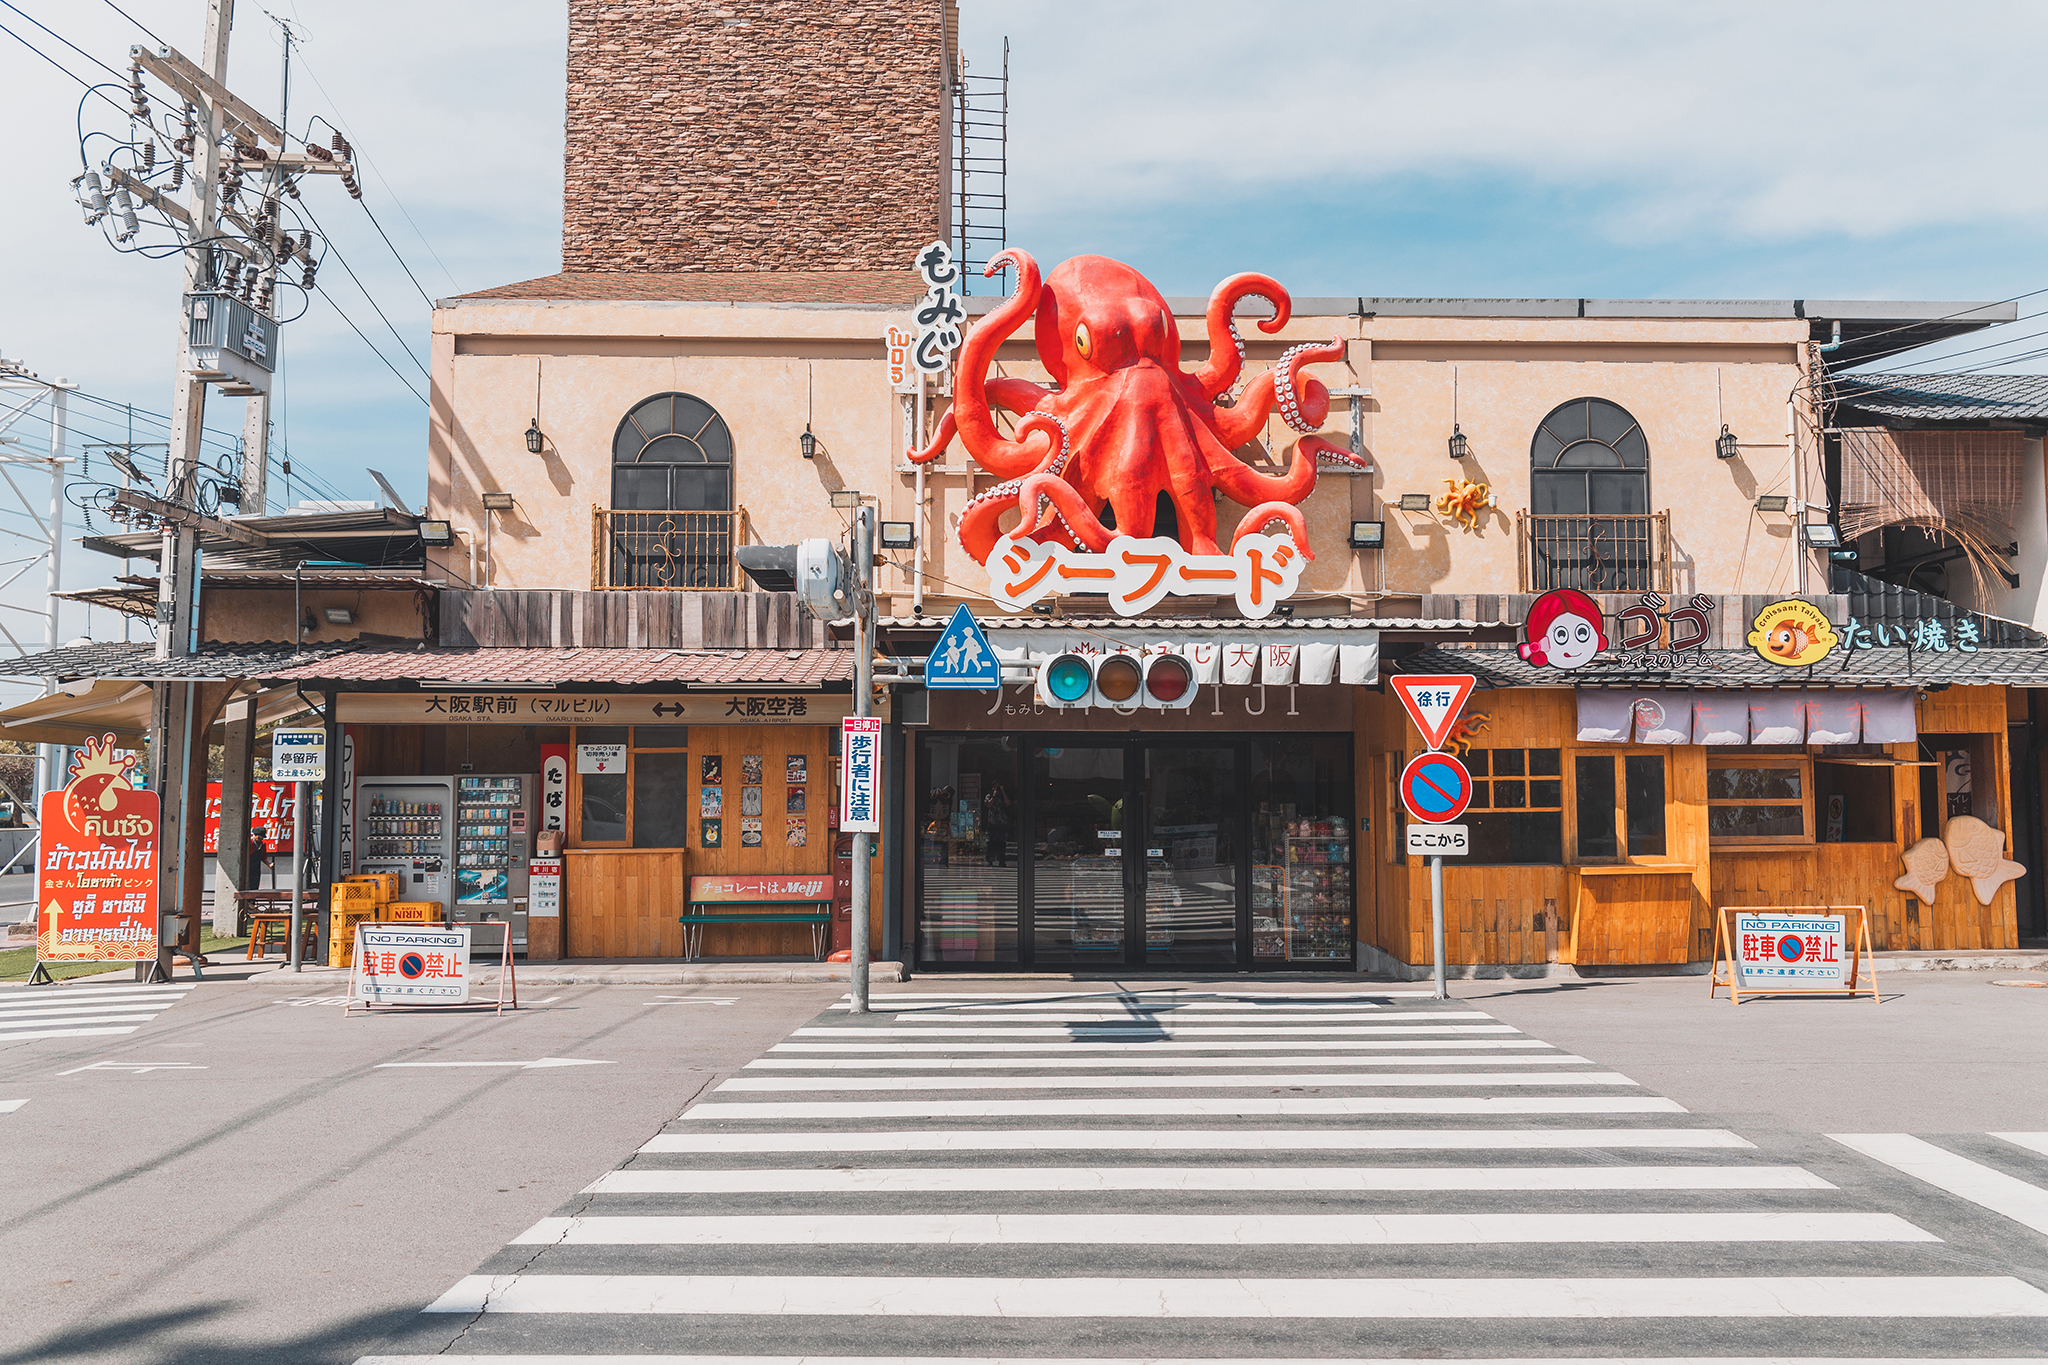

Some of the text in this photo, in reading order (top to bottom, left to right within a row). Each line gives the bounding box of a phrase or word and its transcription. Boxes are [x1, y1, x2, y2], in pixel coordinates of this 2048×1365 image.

[1003, 544, 1295, 606] シーフード
[1618, 591, 1715, 653] ゴゴ
[1759, 605, 1826, 630] Croissant Taiyaki
[1842, 617, 1980, 652] たい焼き
[1617, 653, 1713, 669] アイスクリーム
[725, 696, 808, 717] 大阪空港
[1417, 691, 1451, 708] 徐行
[844, 720, 880, 732] 一旦停止
[280, 752, 319, 764] 停留所
[276, 769, 322, 777] お土産もみじ
[849, 735, 872, 821] 歩行者に注意
[546, 767, 563, 831] たばこ
[84, 813, 154, 837] คินซัง
[1410, 833, 1466, 848] ここから
[45, 838, 153, 871] ข้าวมันไก่
[44, 879, 75, 889] 金さん
[702, 880, 823, 897] チョコレートは Meiji
[394, 910, 422, 919] KIRIN
[61, 915, 153, 947] อาหารญี่ปุ่น
[1746, 921, 1836, 931] NO PARKING
[371, 935, 458, 945] NO PARKING
[1742, 933, 1839, 963] 駐車 禁止
[362, 951, 463, 978] 駐車 禁止
[1745, 967, 1836, 976] 駐車ご遠慮ください
